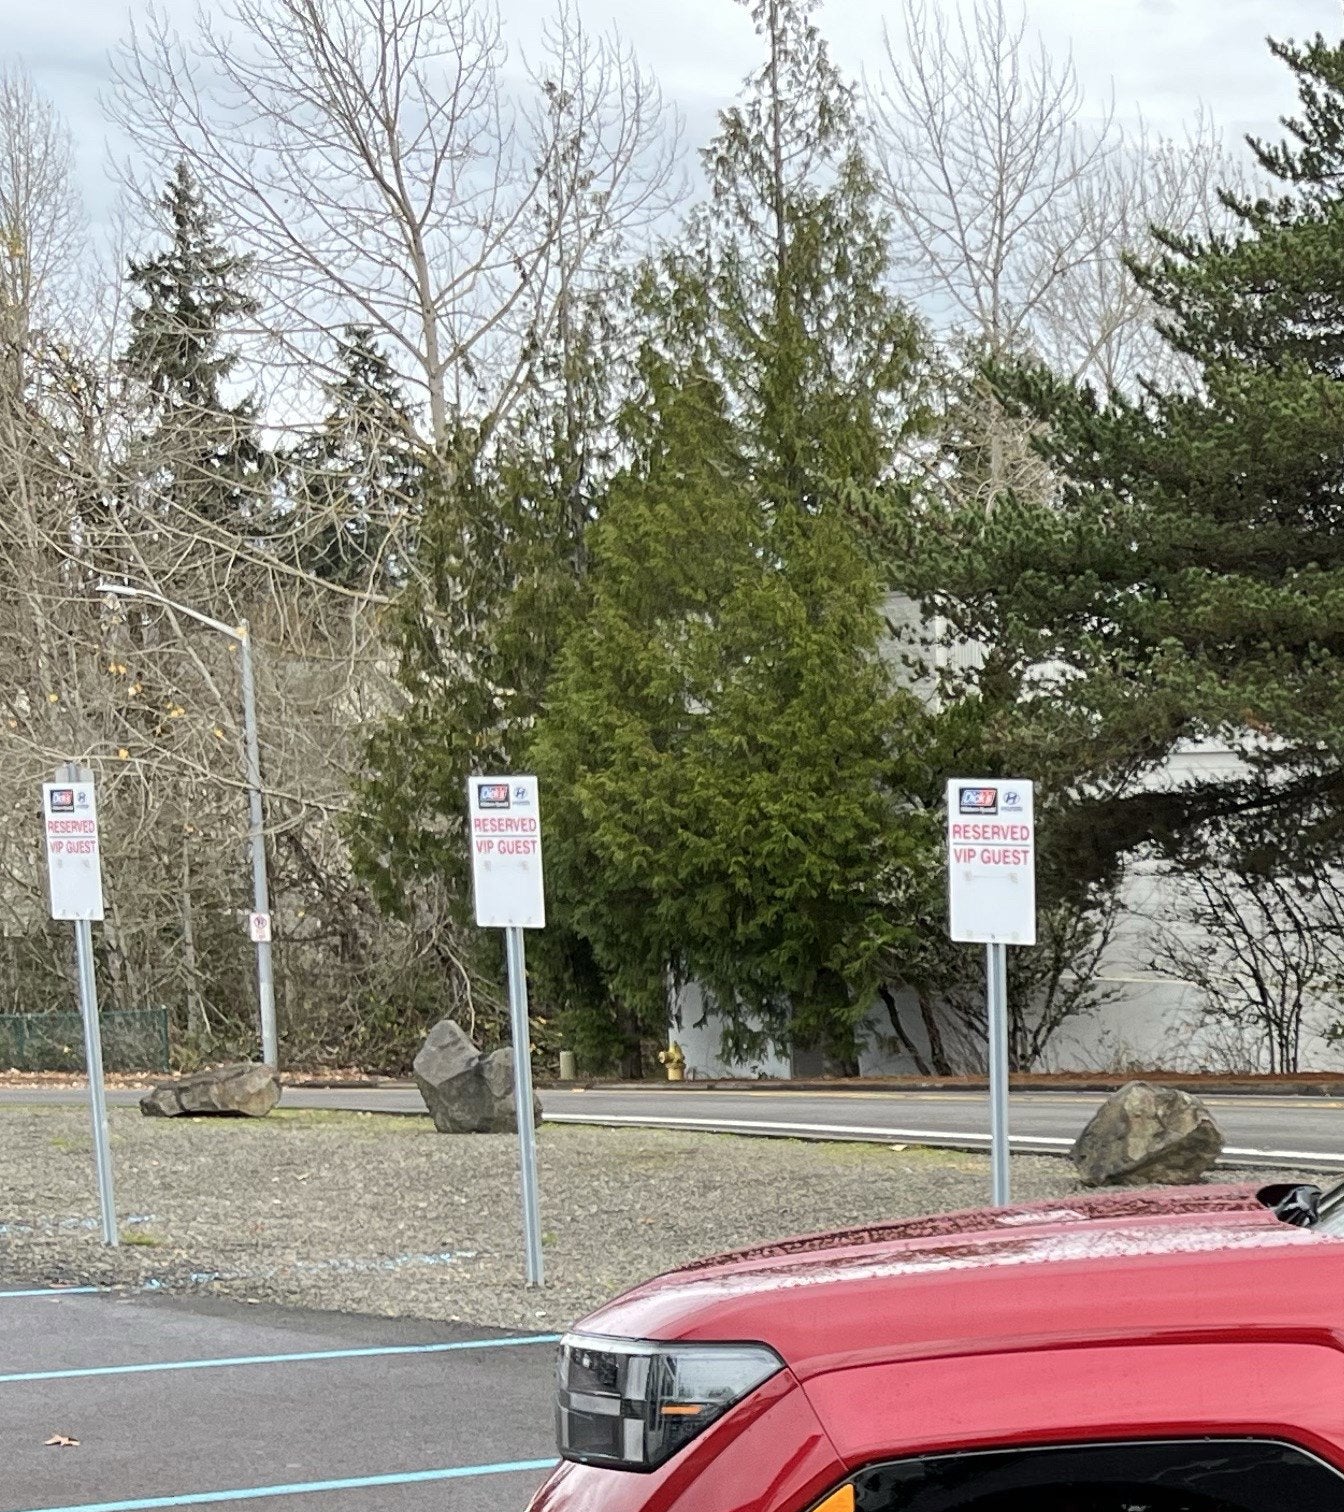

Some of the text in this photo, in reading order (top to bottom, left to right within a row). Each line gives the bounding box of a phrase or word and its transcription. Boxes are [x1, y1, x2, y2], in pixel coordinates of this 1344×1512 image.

[48, 820, 95, 834] RESERVED
[474, 818, 537, 833] RESERVED
[952, 823, 1030, 842] RESERVED
[50, 840, 96, 854] VIP GUEST
[476, 840, 538, 855] VIP GUEST
[953, 848, 1030, 865] VIP GUEST
